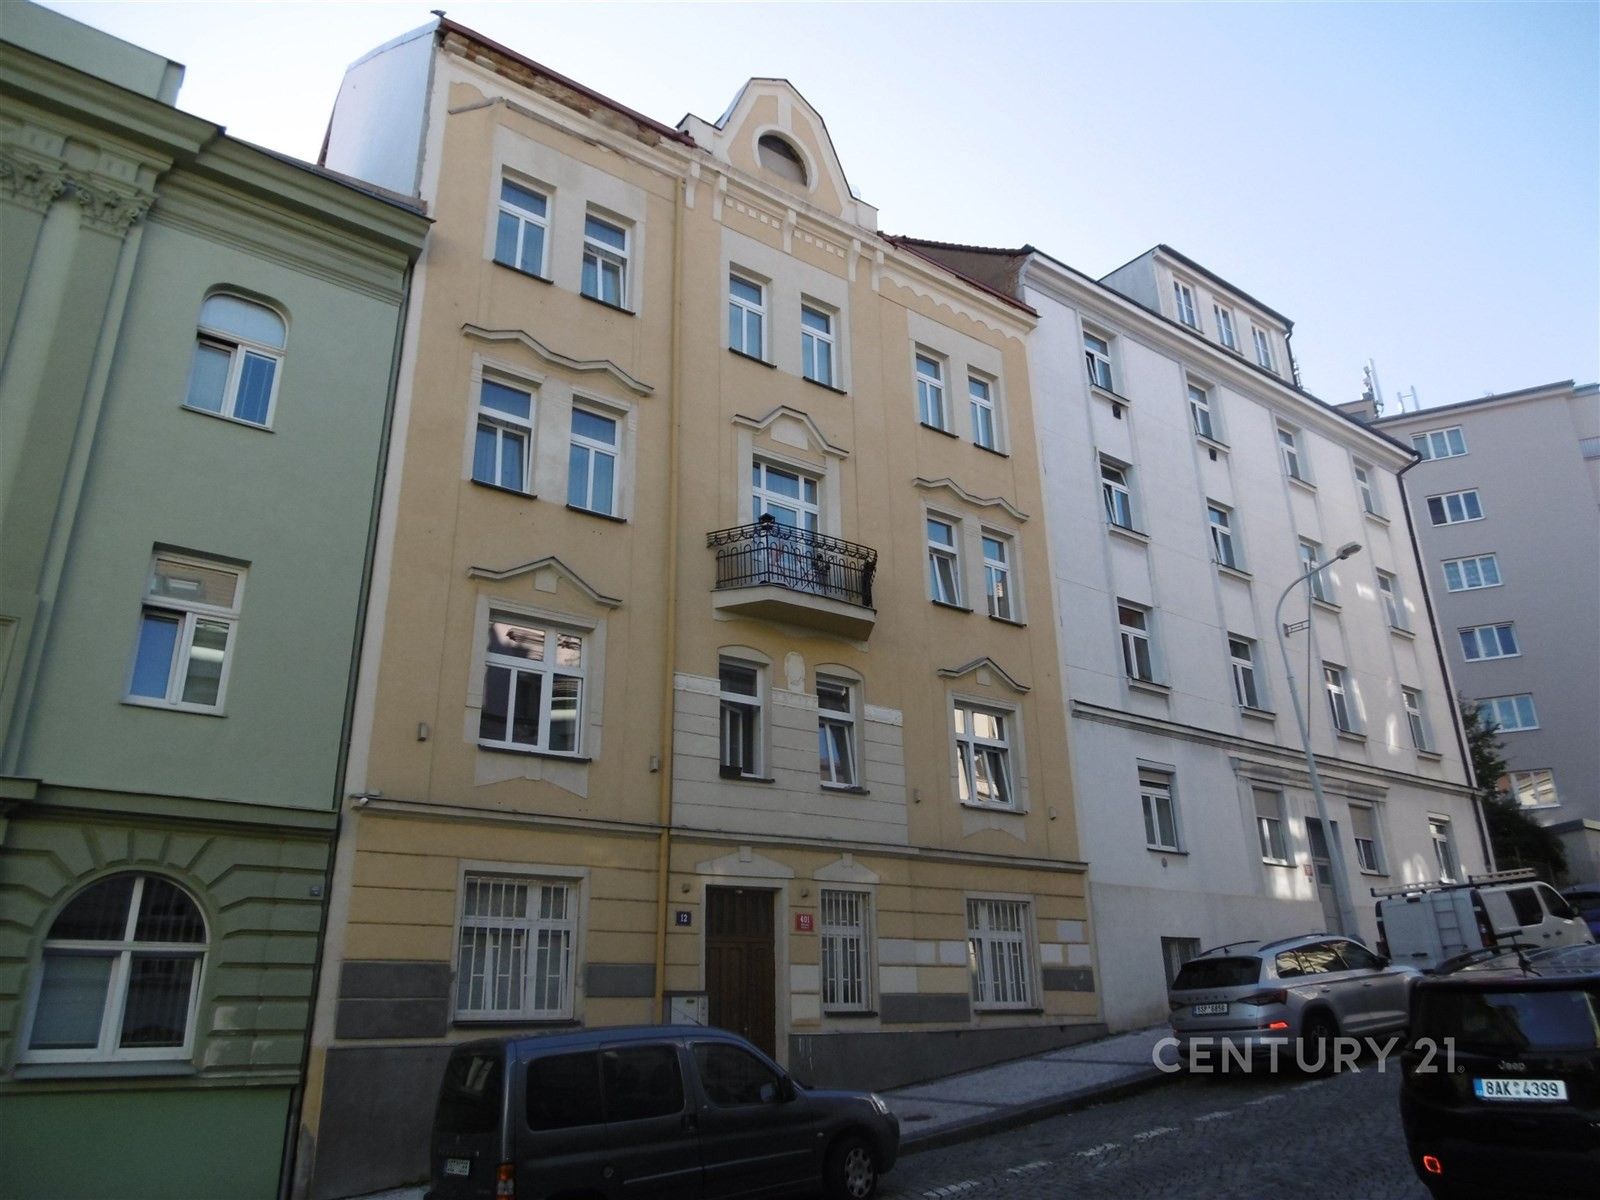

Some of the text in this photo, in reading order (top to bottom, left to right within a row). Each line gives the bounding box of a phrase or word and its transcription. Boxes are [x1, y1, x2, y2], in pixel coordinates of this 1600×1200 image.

[1499, 1060, 1526, 1071] Jeep
[1485, 1081, 1560, 1097] 8AK 4399
